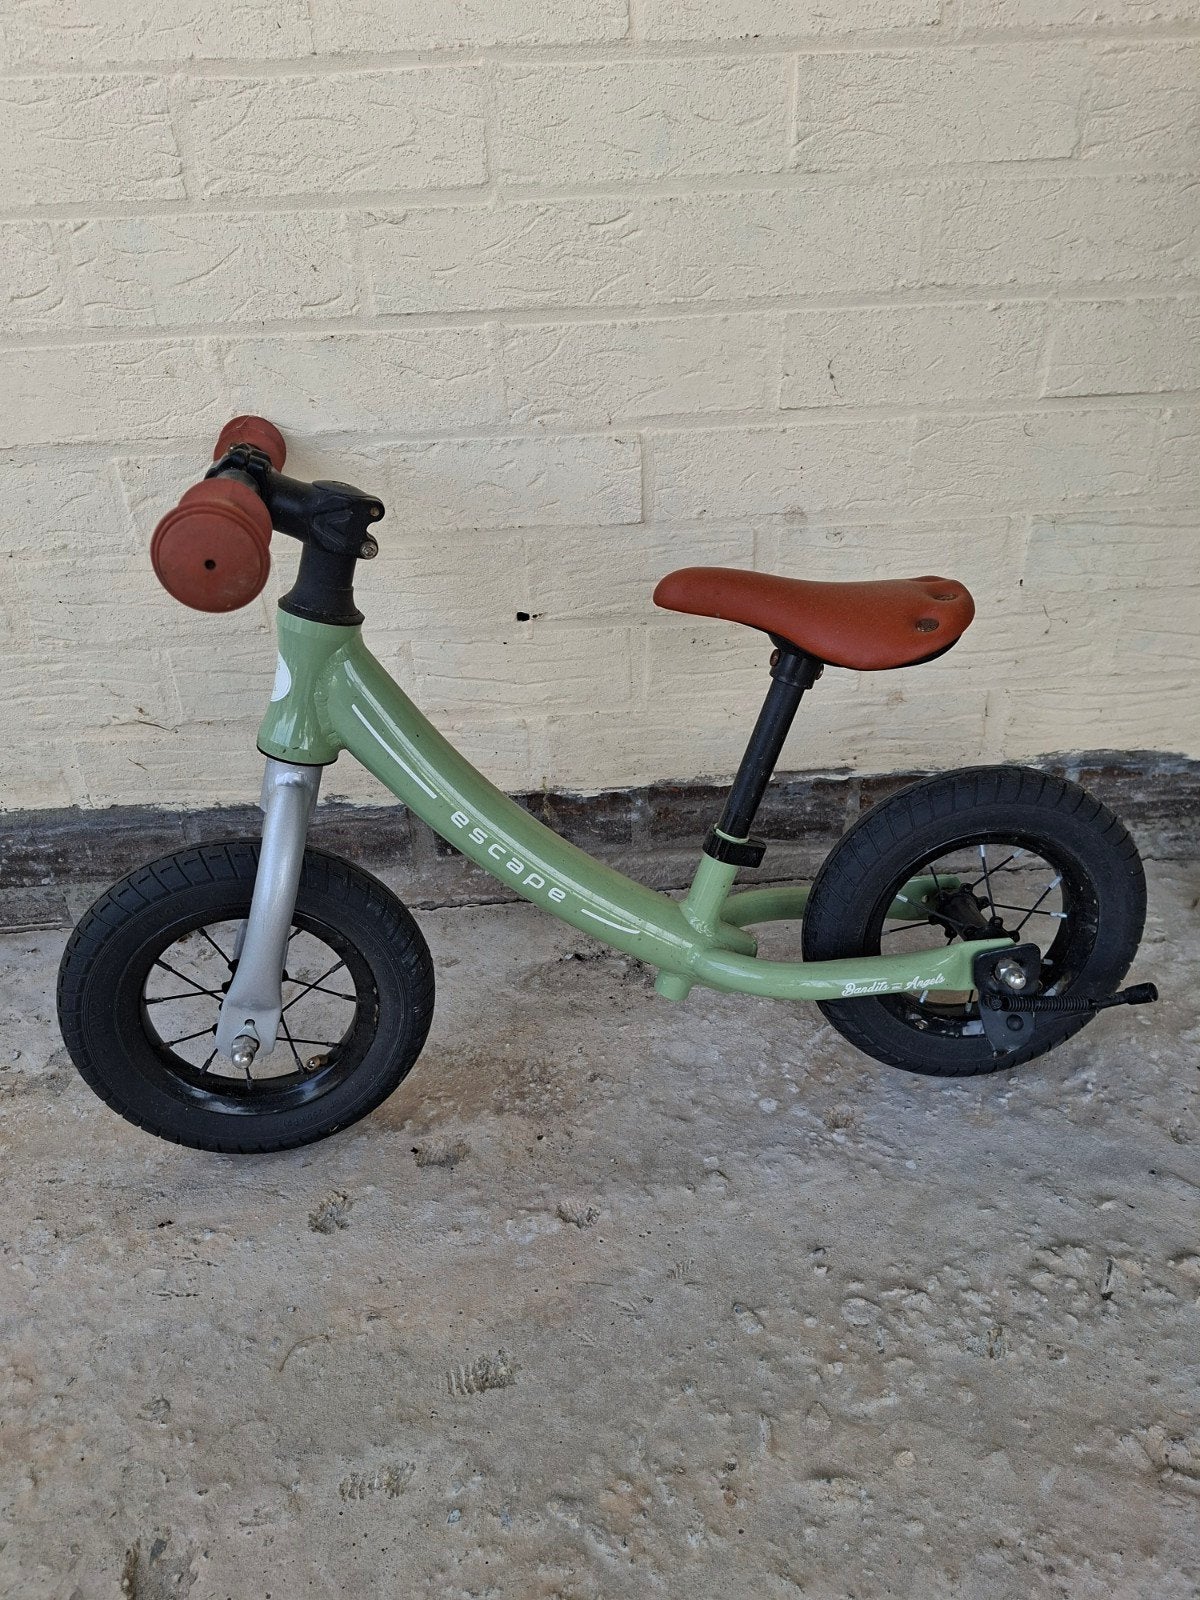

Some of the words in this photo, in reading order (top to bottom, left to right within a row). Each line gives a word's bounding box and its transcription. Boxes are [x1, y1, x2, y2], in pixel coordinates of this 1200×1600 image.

[450, 811, 566, 903] escape
[842, 981, 889, 997] Bandits
[904, 973, 946, 990] Angels
